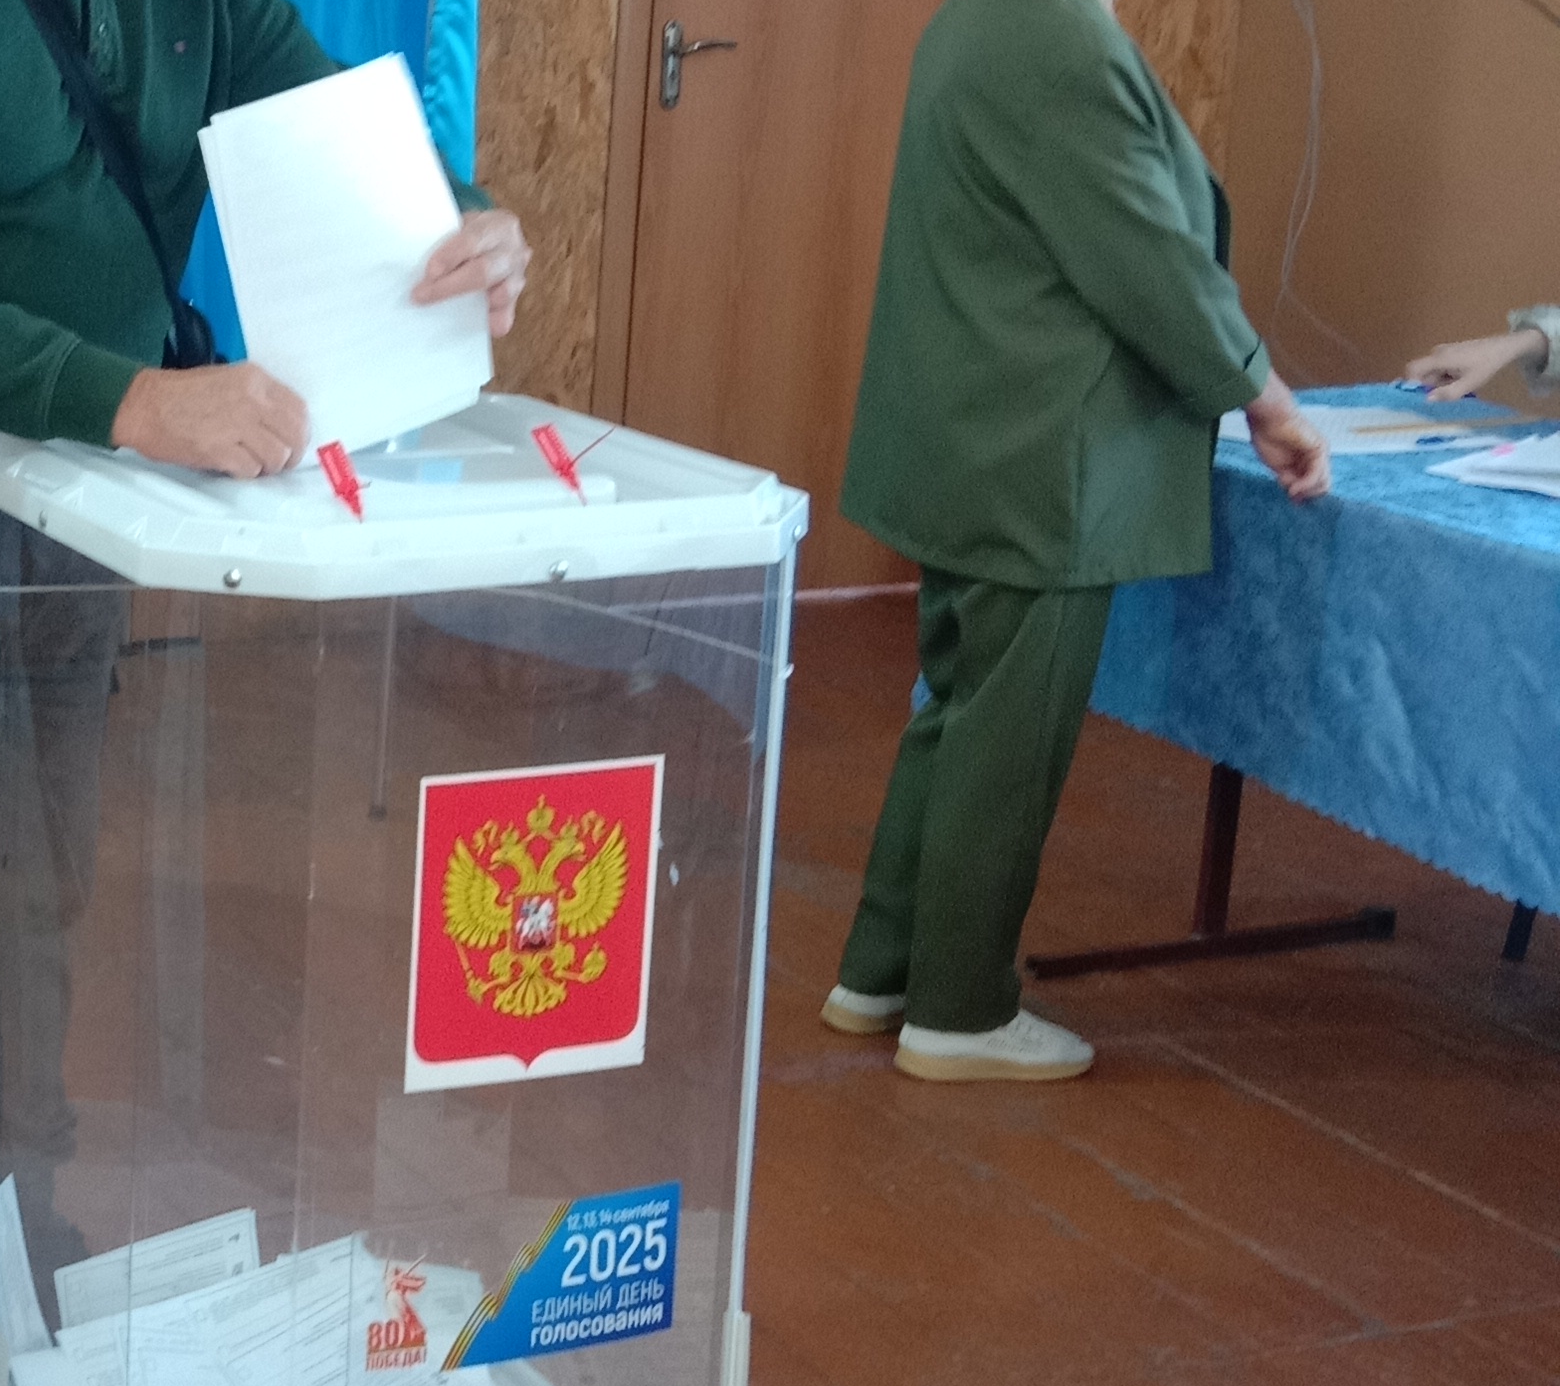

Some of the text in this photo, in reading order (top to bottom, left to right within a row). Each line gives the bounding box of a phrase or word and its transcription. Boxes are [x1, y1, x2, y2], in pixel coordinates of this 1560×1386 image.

[612, 1199, 670, 1224] сентября
[561, 1217, 667, 1288] 2025
[531, 1277, 665, 1324] ЕДИНЫЙ ДЕНЬ
[368, 1319, 401, 1353] 80
